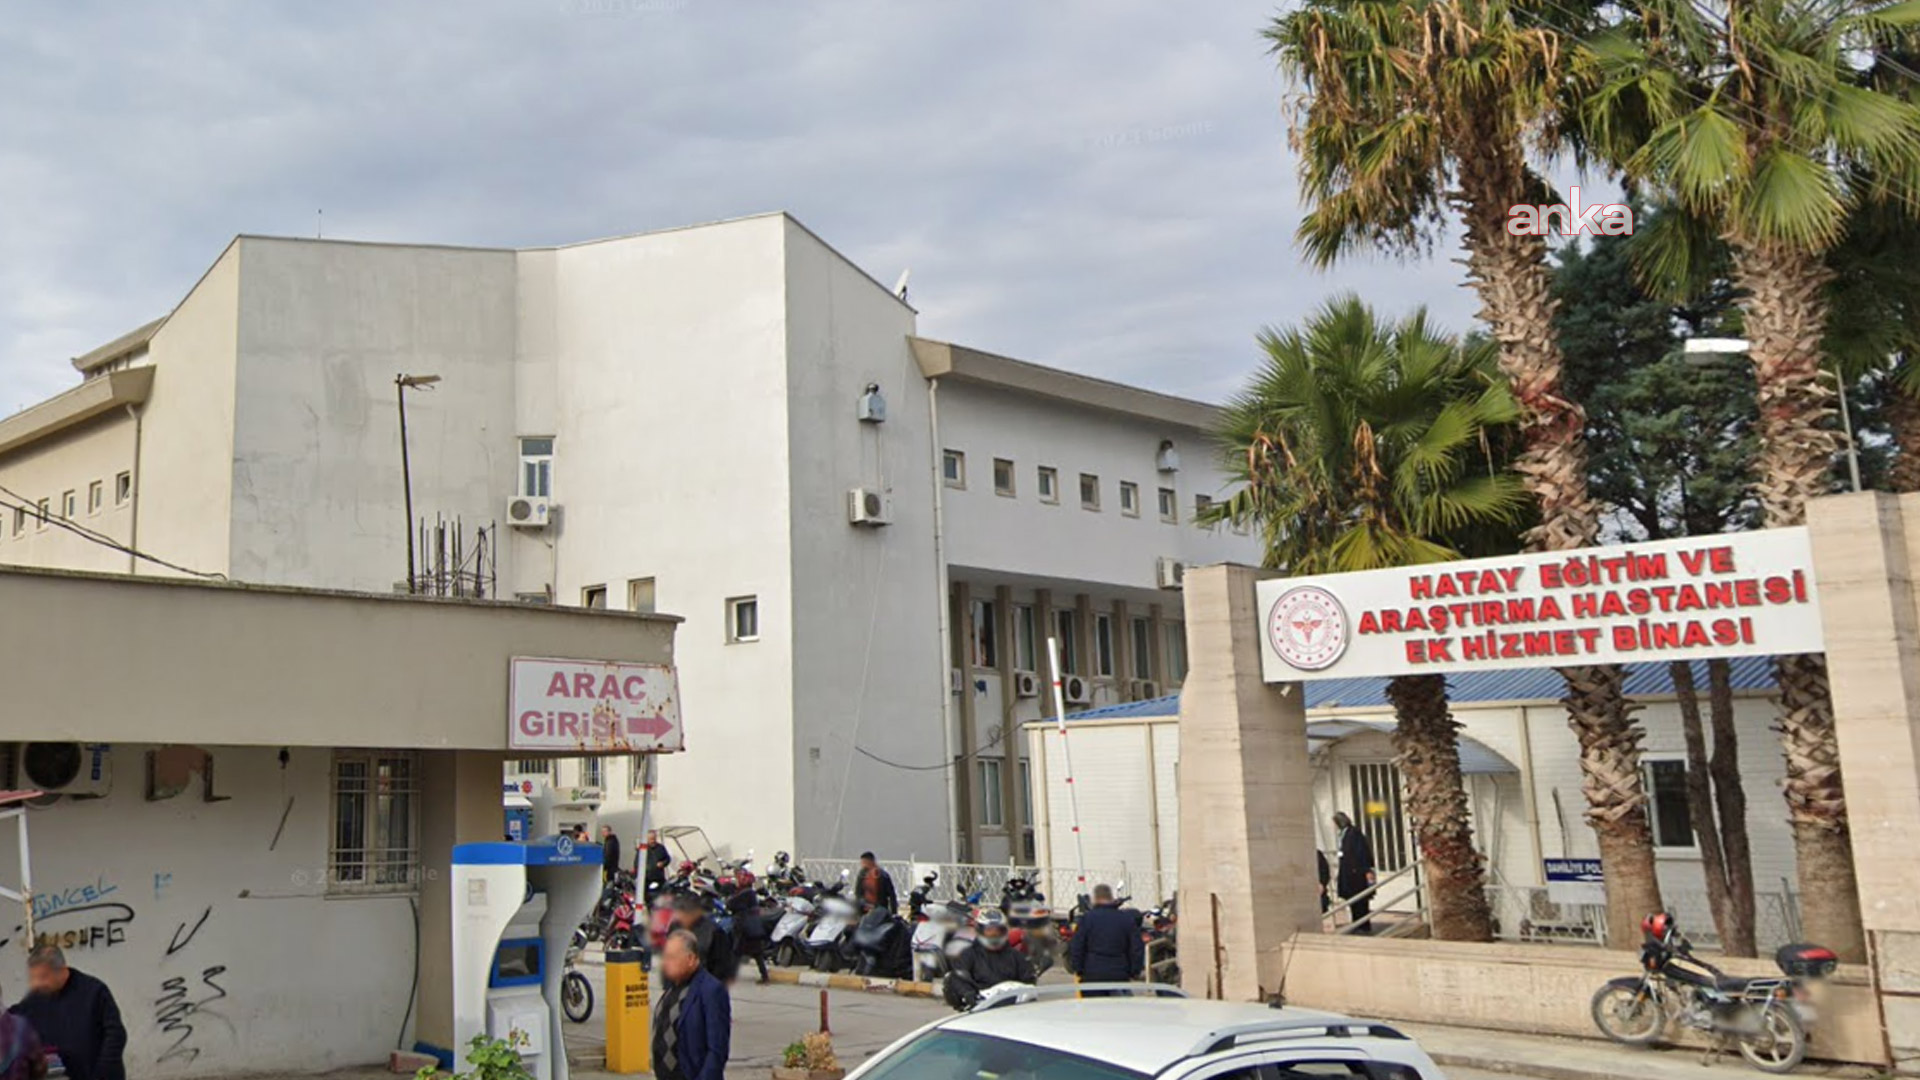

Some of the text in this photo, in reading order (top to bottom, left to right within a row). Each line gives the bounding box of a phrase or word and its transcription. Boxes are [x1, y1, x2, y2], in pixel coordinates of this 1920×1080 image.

[1409, 546, 1736, 600] HATAY EĞİTİM VE
[1358, 596, 1566, 634] ARAŞTIRMA
[1571, 569, 1809, 618] HASTANESİ
[1405, 617, 1756, 664] EK HİZMET BİNASI
[546, 671, 647, 705] ARAÇ
